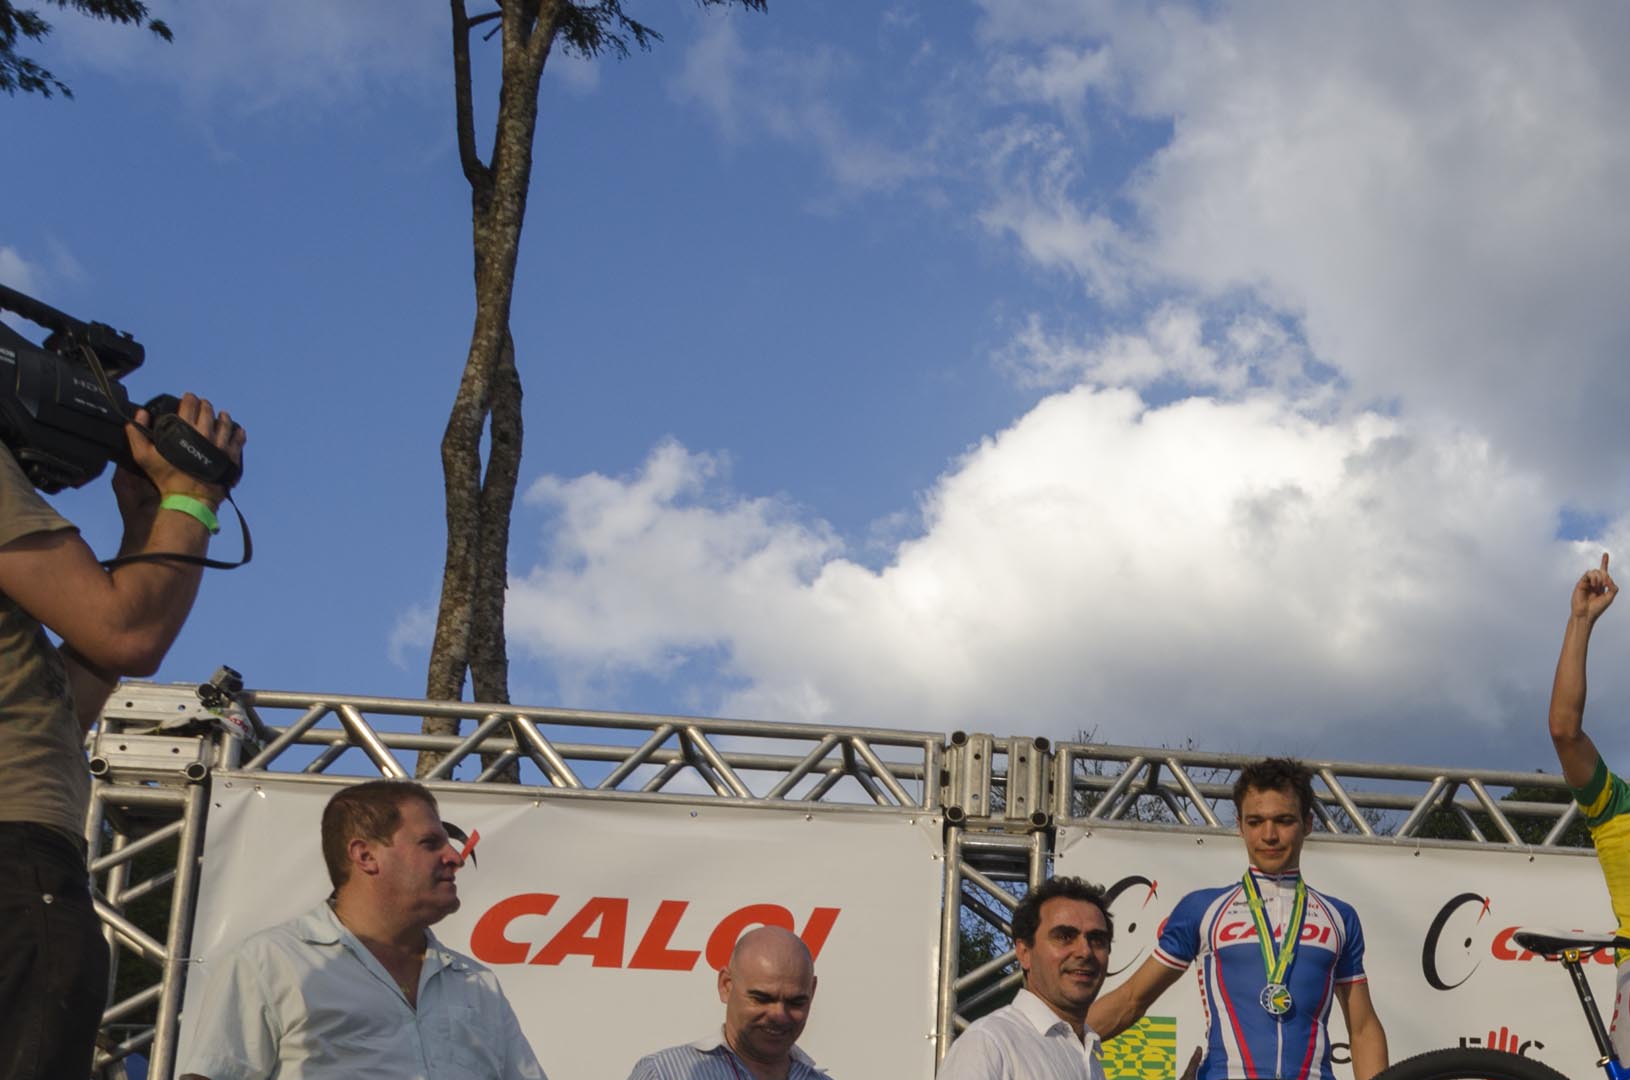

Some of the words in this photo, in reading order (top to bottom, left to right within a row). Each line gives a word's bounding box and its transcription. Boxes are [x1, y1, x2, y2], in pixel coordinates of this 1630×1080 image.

[178, 438, 212, 466] SONY
[469, 892, 842, 973] CALOI
[1218, 921, 1331, 944] CAOI
